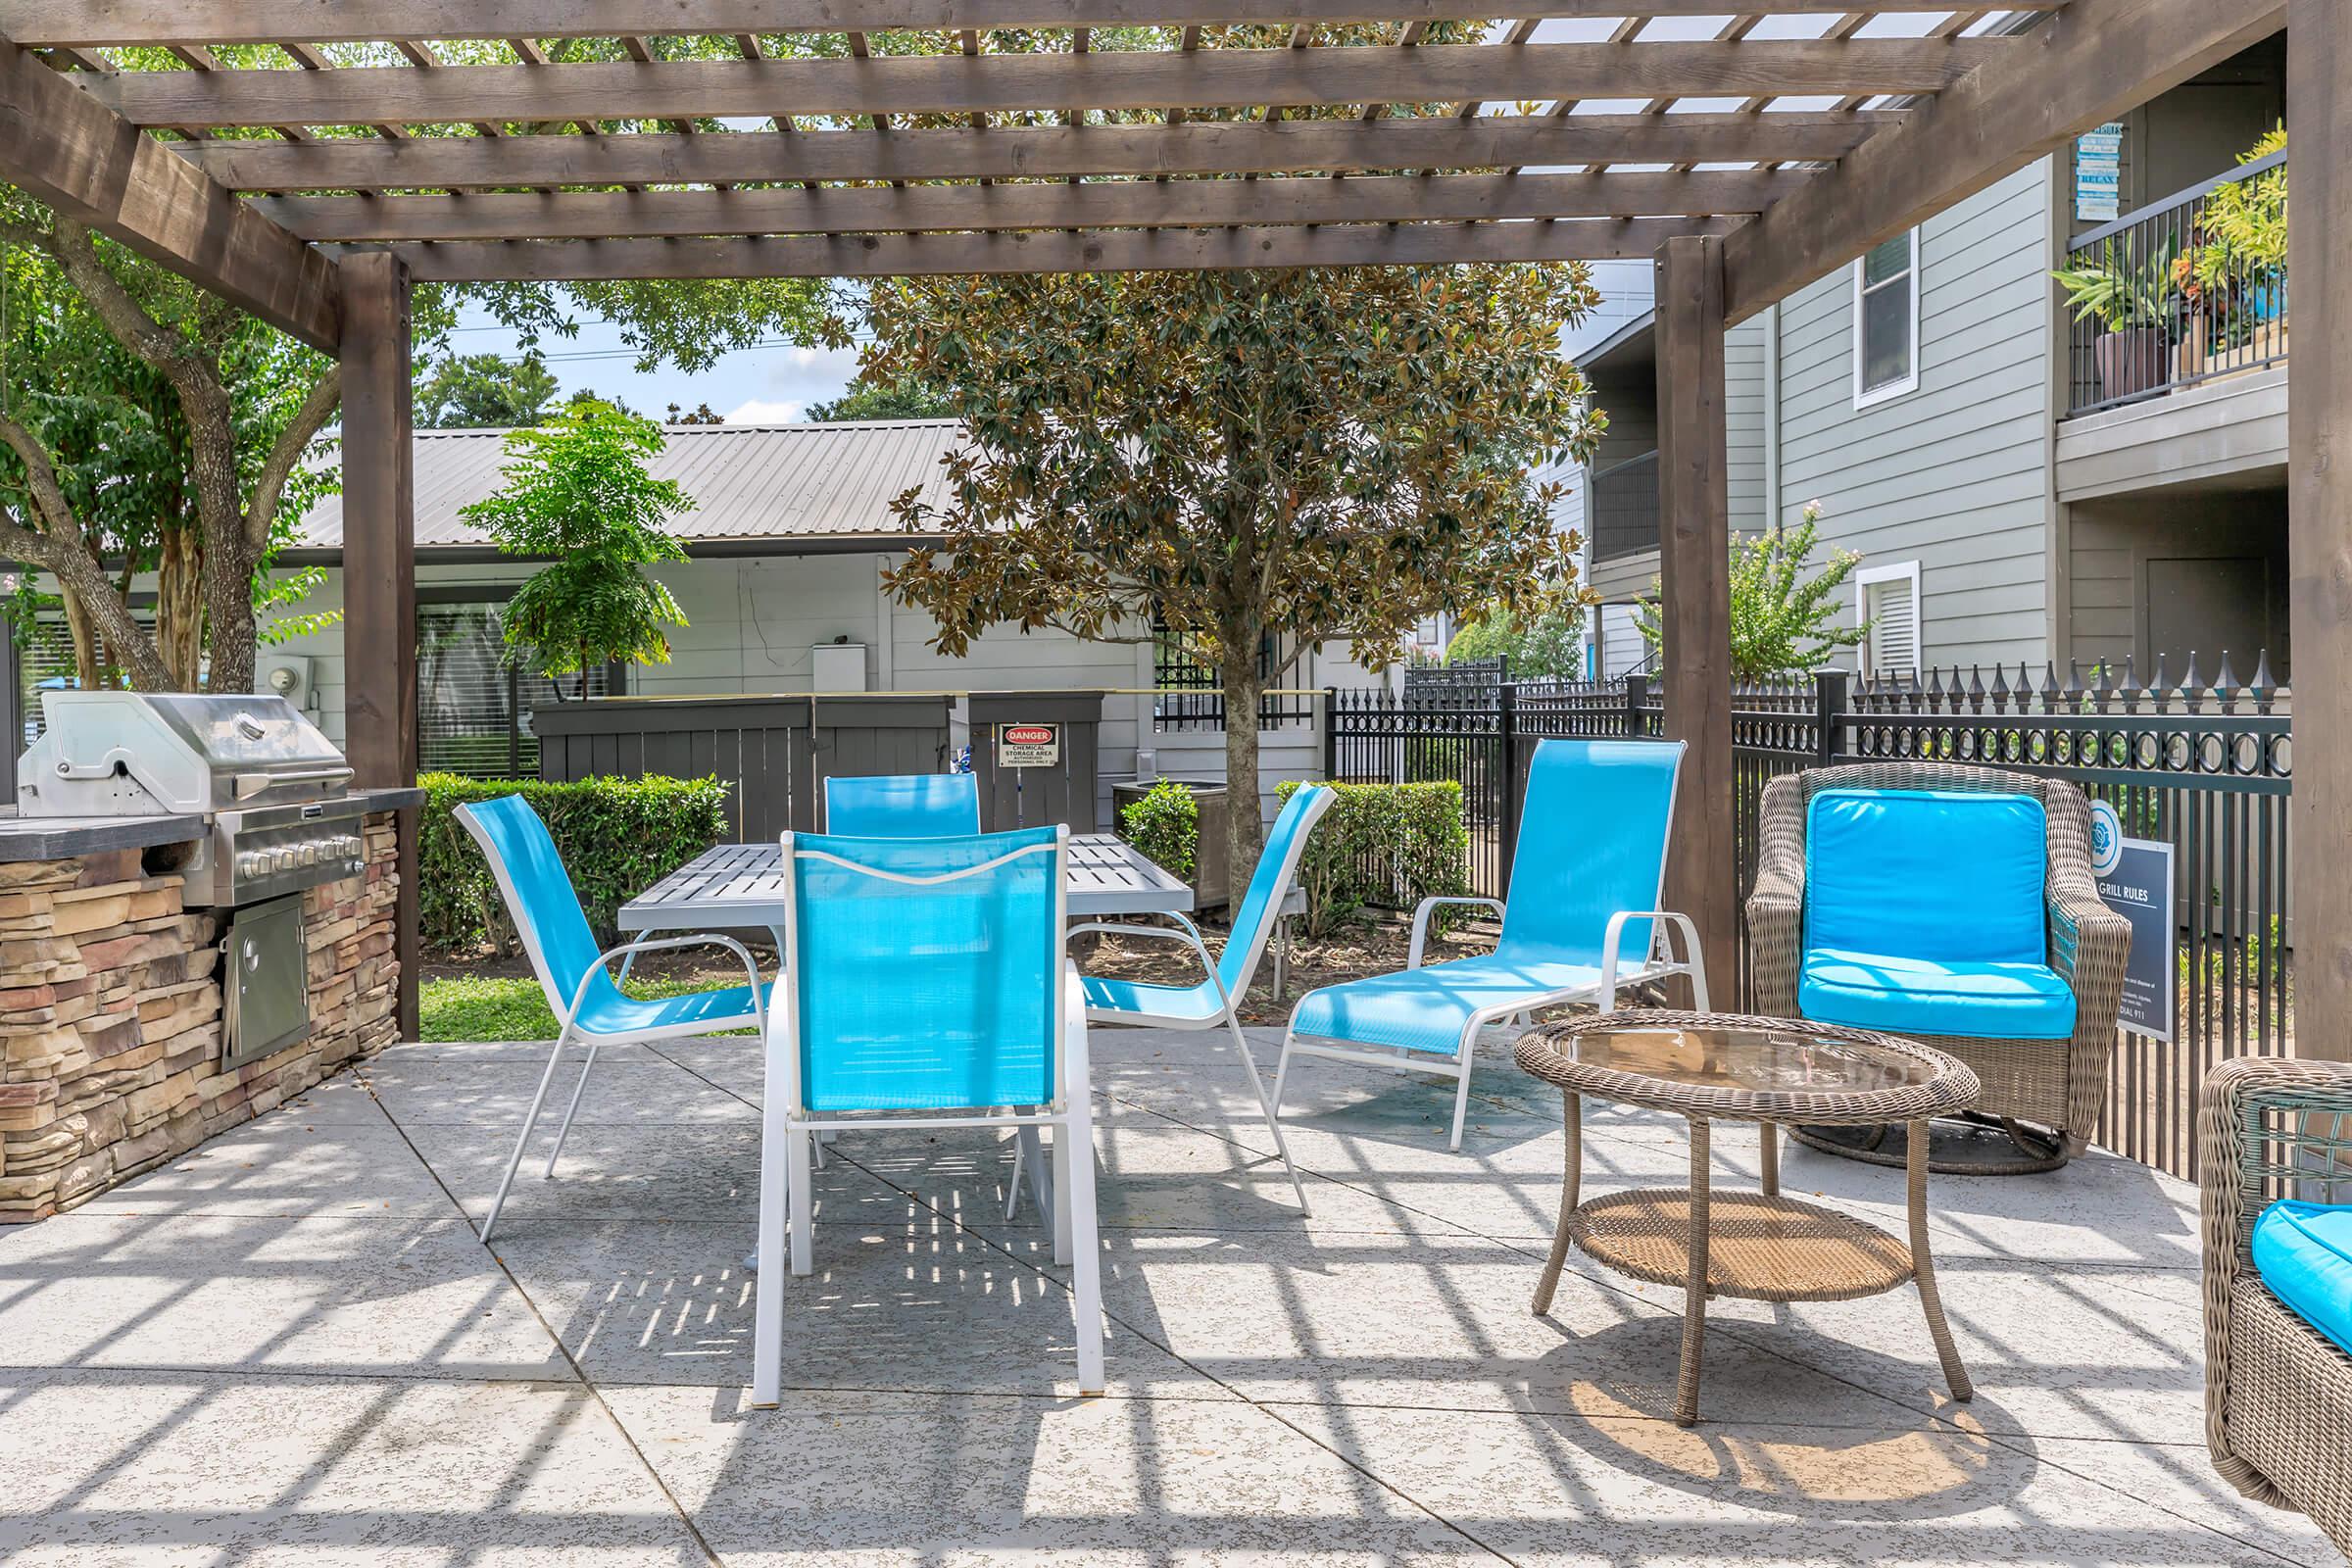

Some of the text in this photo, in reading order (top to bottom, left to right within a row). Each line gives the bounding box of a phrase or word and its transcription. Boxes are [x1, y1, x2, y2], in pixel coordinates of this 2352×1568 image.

[2082, 175, 2114, 184] RELAX
[1009, 731, 1049, 740] DANGER
[2099, 882, 2148, 903] GRILL RULES
[2120, 1005, 2144, 1020] DIAL 911
